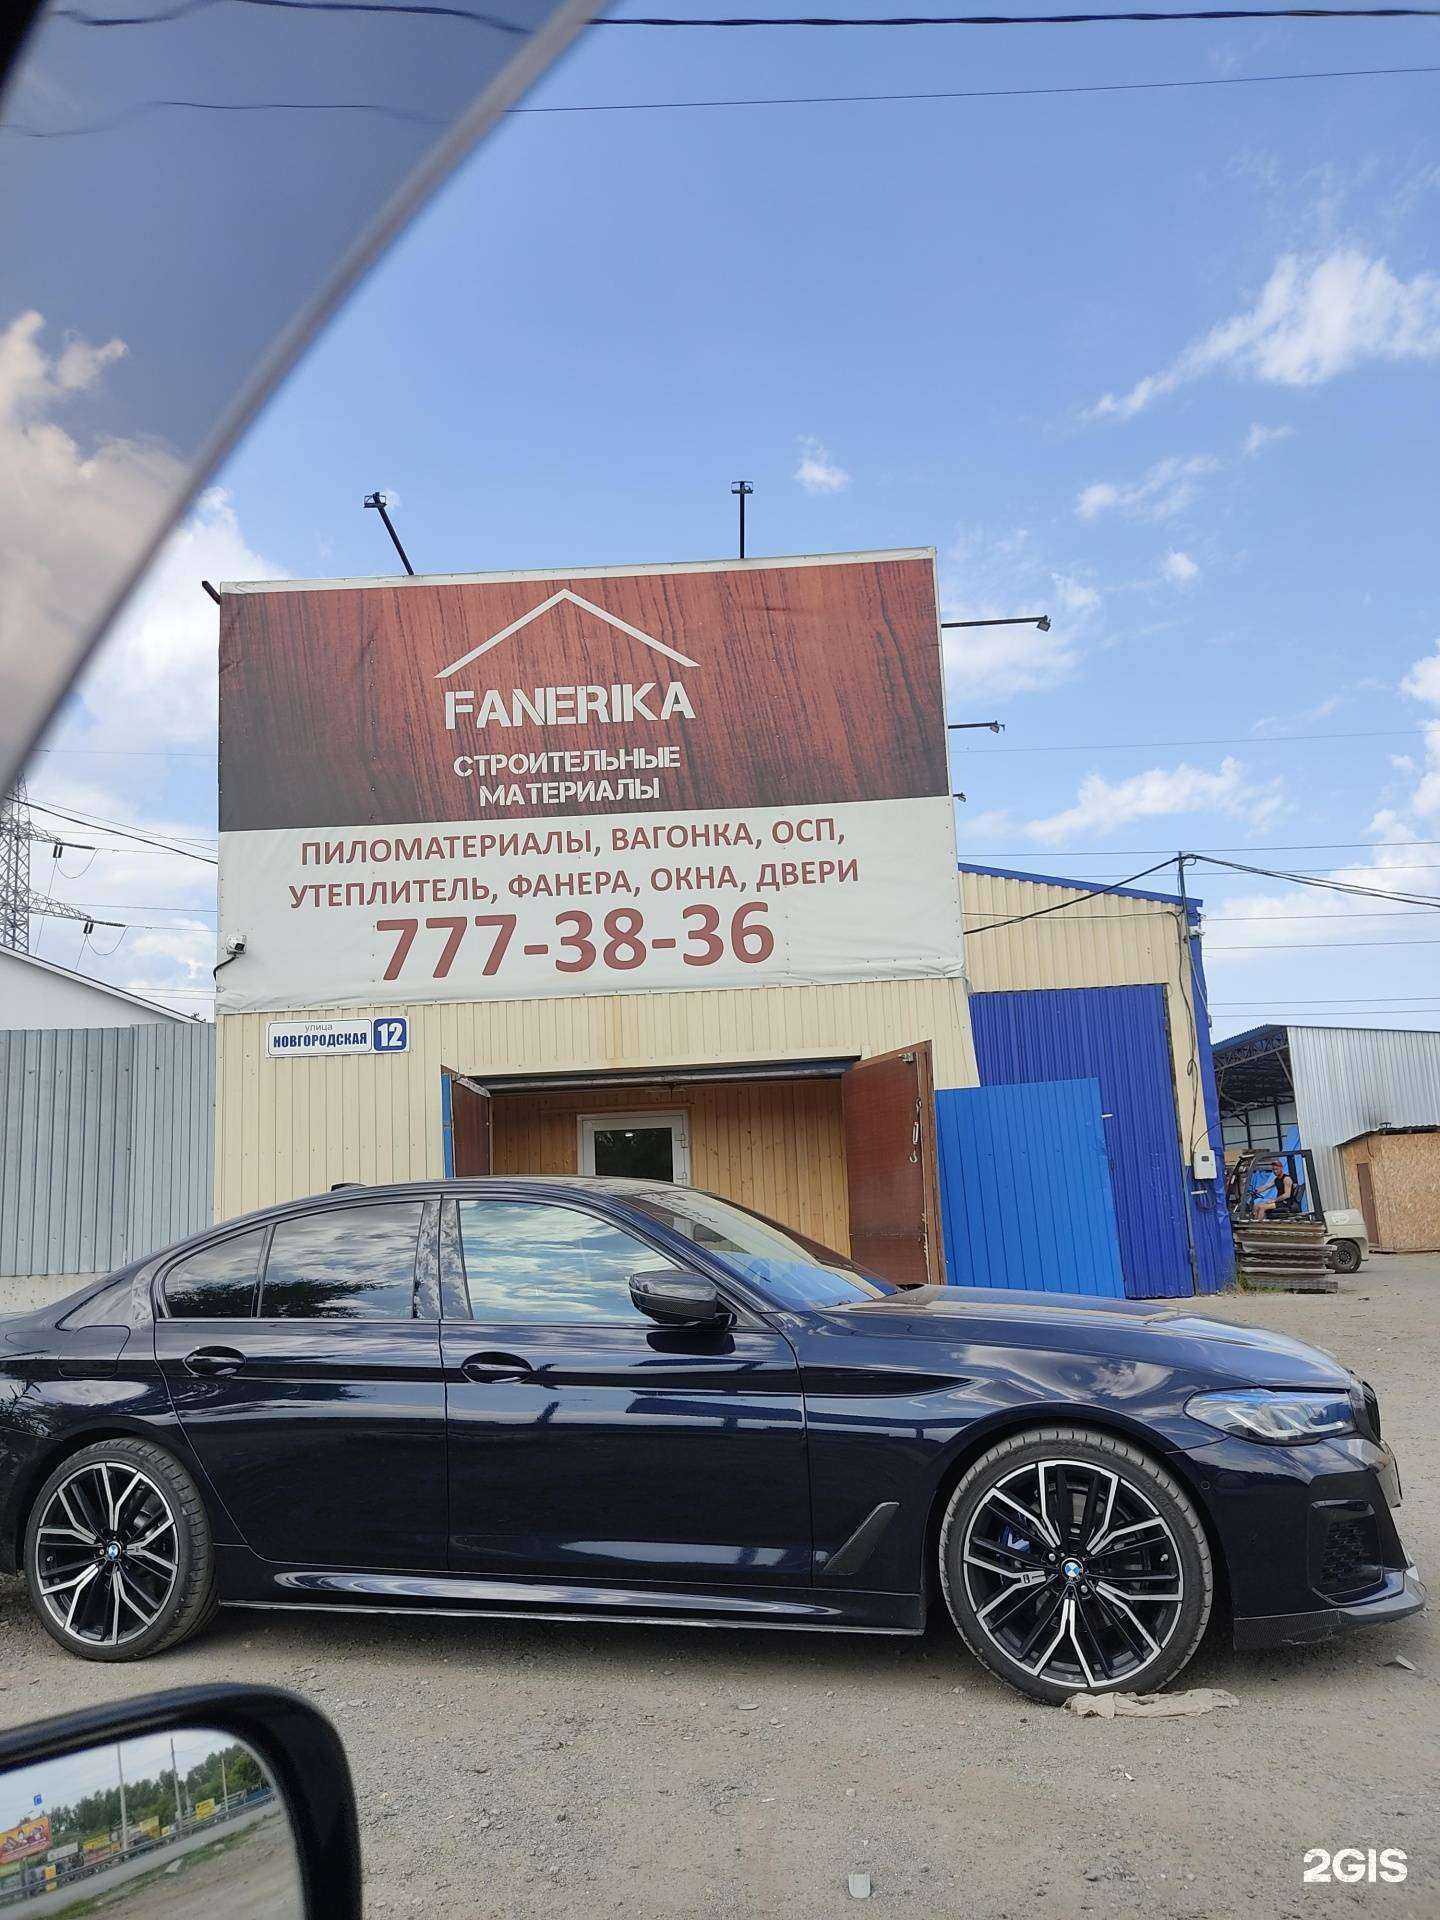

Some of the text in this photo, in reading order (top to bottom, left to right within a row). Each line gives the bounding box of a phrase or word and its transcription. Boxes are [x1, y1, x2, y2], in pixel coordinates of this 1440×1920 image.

[444, 681, 696, 730] FANERIKA
[453, 746, 681, 777] СТРОИТЕЛЬНЫЕ
[479, 778, 660, 807] МАТЕРИАЛЫ
[301, 817, 845, 865] ПИЛОМАТЕРИАЛЫ, ВАГОНКА, ОСП,
[288, 858, 859, 909] УТЕПЛИТЕЛЬ, ФАНЕРА, ОКНА, ДВЕРИ
[376, 901, 775, 981] 777-38-36
[273, 1032, 367, 1048] НОВГОРОДСКАЯ
[304, 1024, 333, 1033] улица
[377, 1022, 403, 1047] 12
